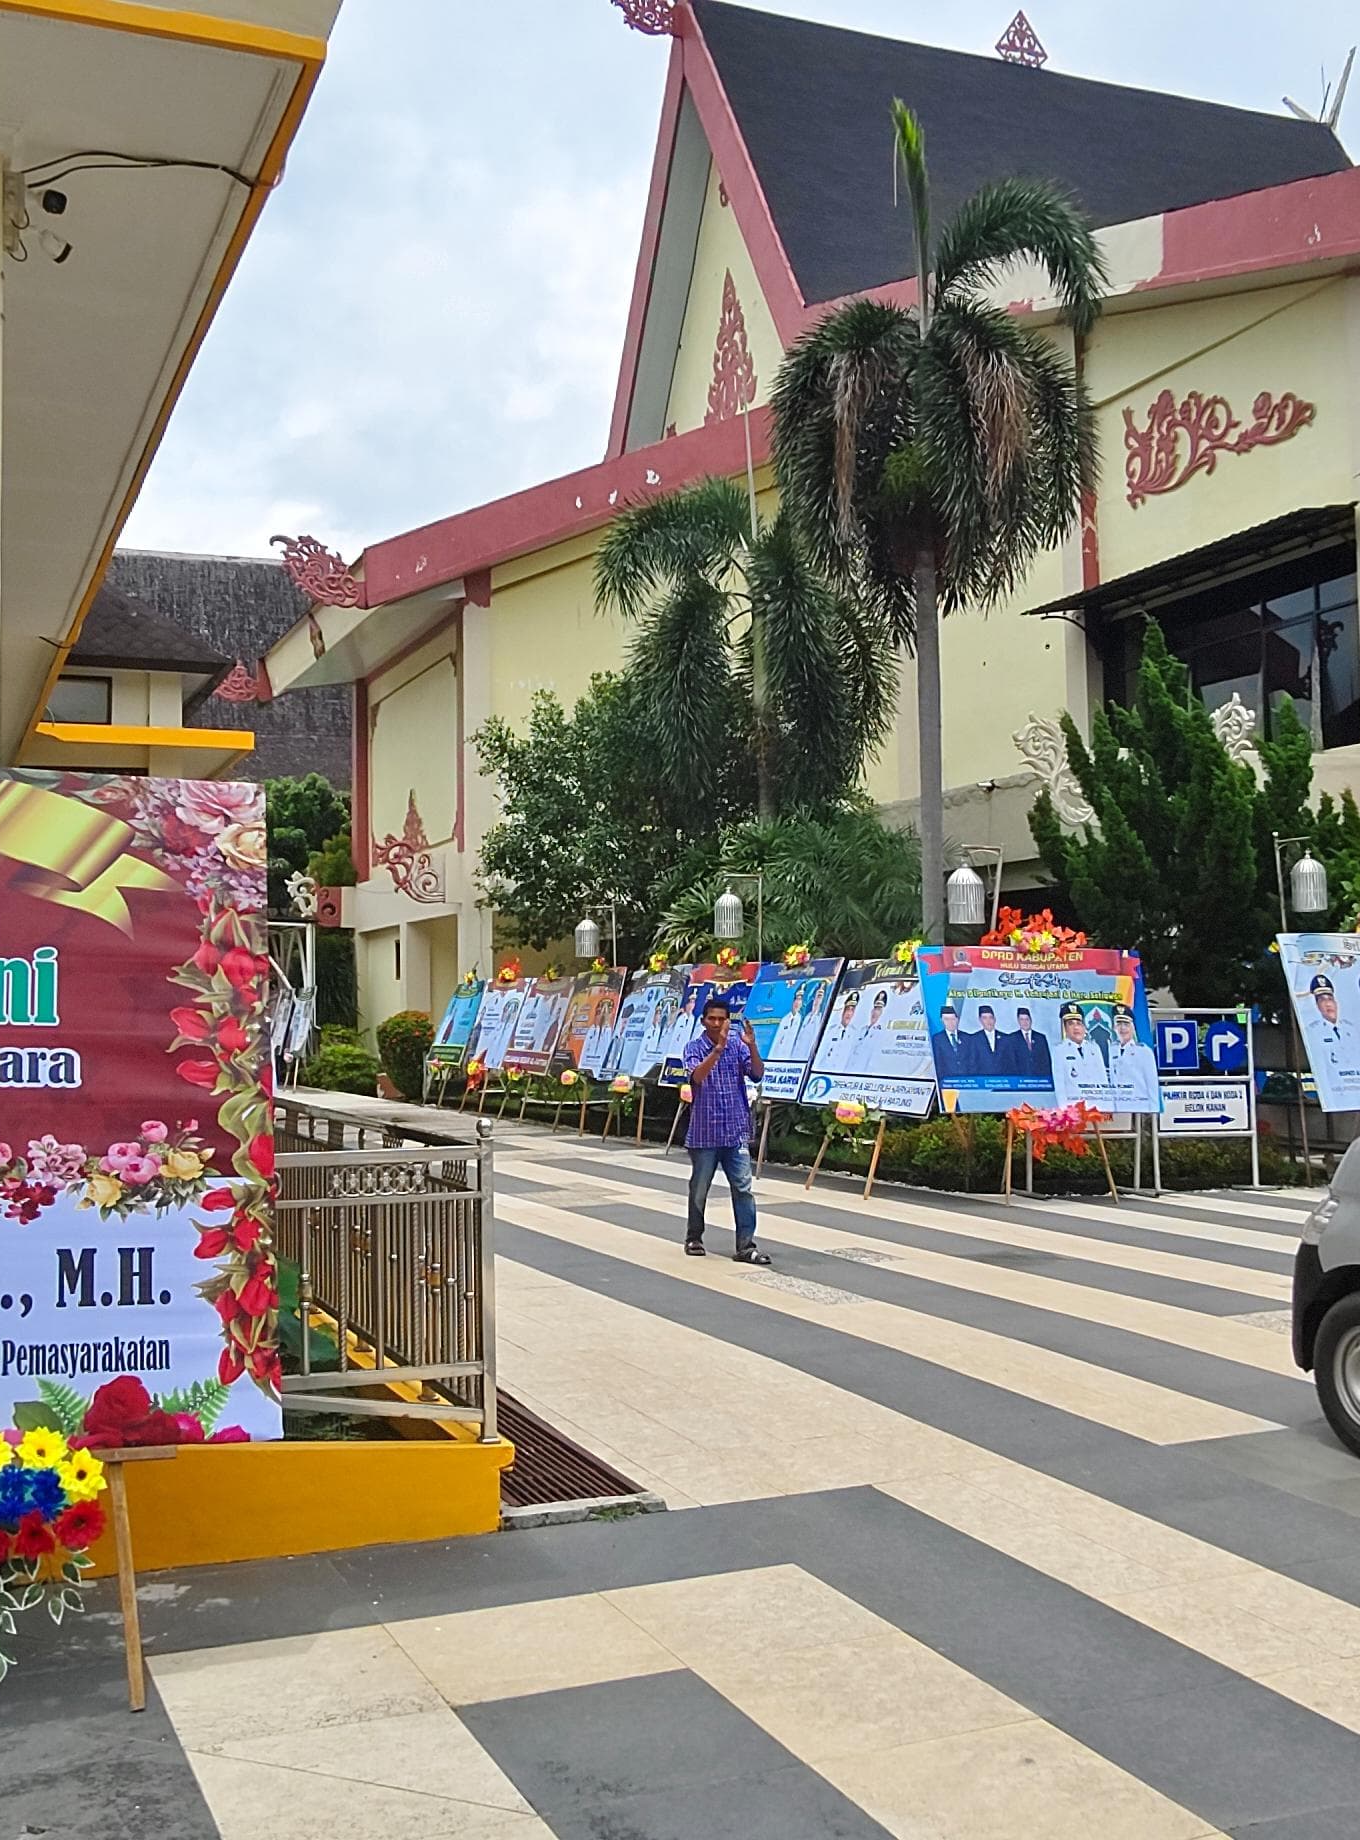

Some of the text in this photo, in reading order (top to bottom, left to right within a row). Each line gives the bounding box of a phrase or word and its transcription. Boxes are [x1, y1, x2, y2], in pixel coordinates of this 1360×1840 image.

[981, 949, 1084, 962] DPRD KABUPATEN
[1164, 1026, 1190, 1064] P
[55, 1246, 173, 1309] M.H.
[0, 1335, 174, 1380] Pemasyarakatan
